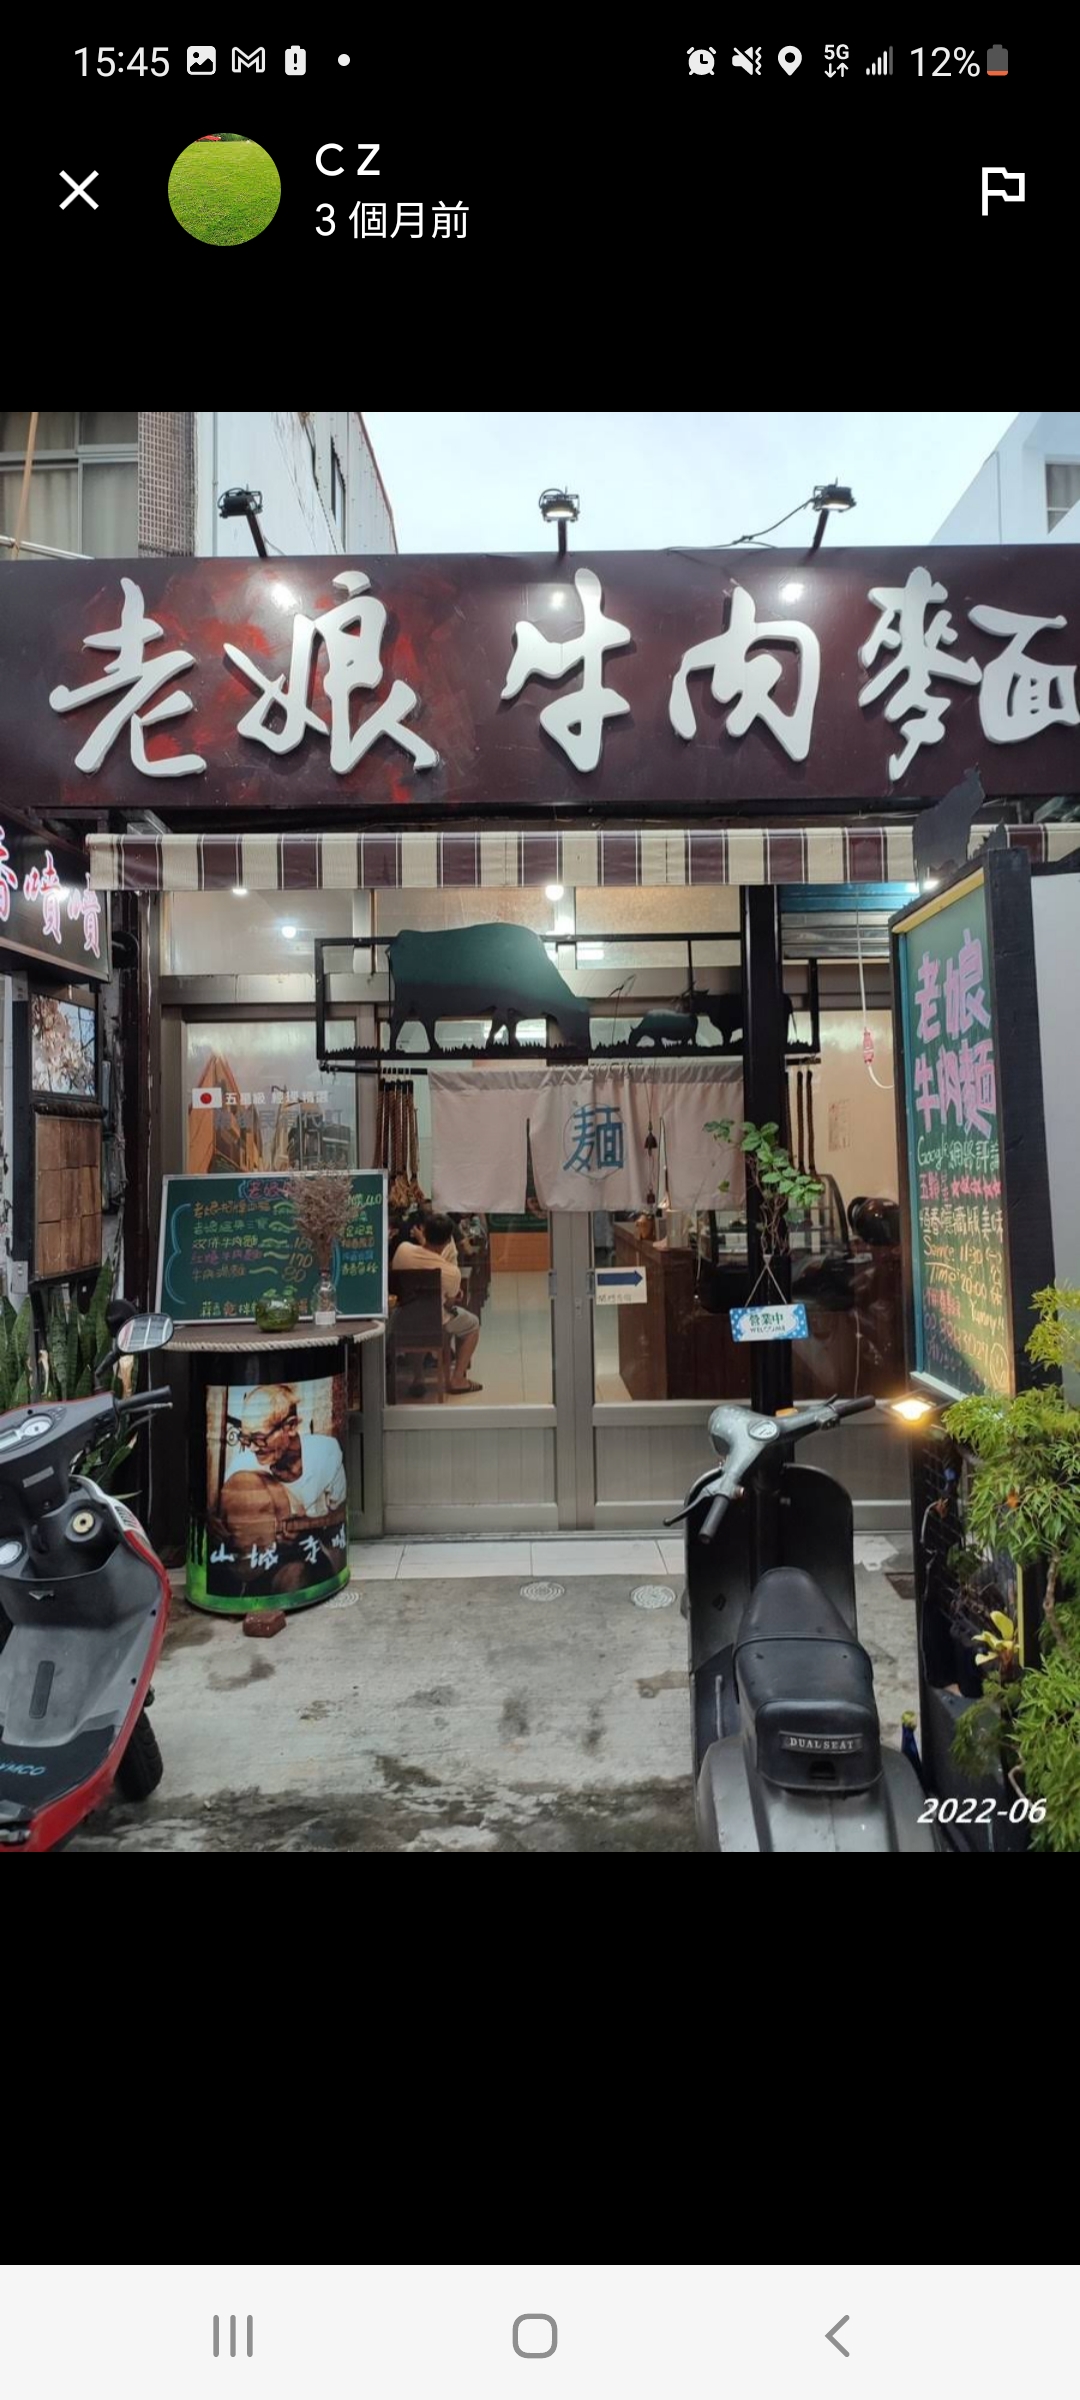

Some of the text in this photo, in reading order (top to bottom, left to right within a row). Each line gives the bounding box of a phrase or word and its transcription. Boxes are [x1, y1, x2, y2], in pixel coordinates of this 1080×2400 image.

[500, 566, 1080, 782] 牛肉麵
[914, 926, 992, 1045] 老娘
[914, 1038, 998, 1140] 牛肉麵
